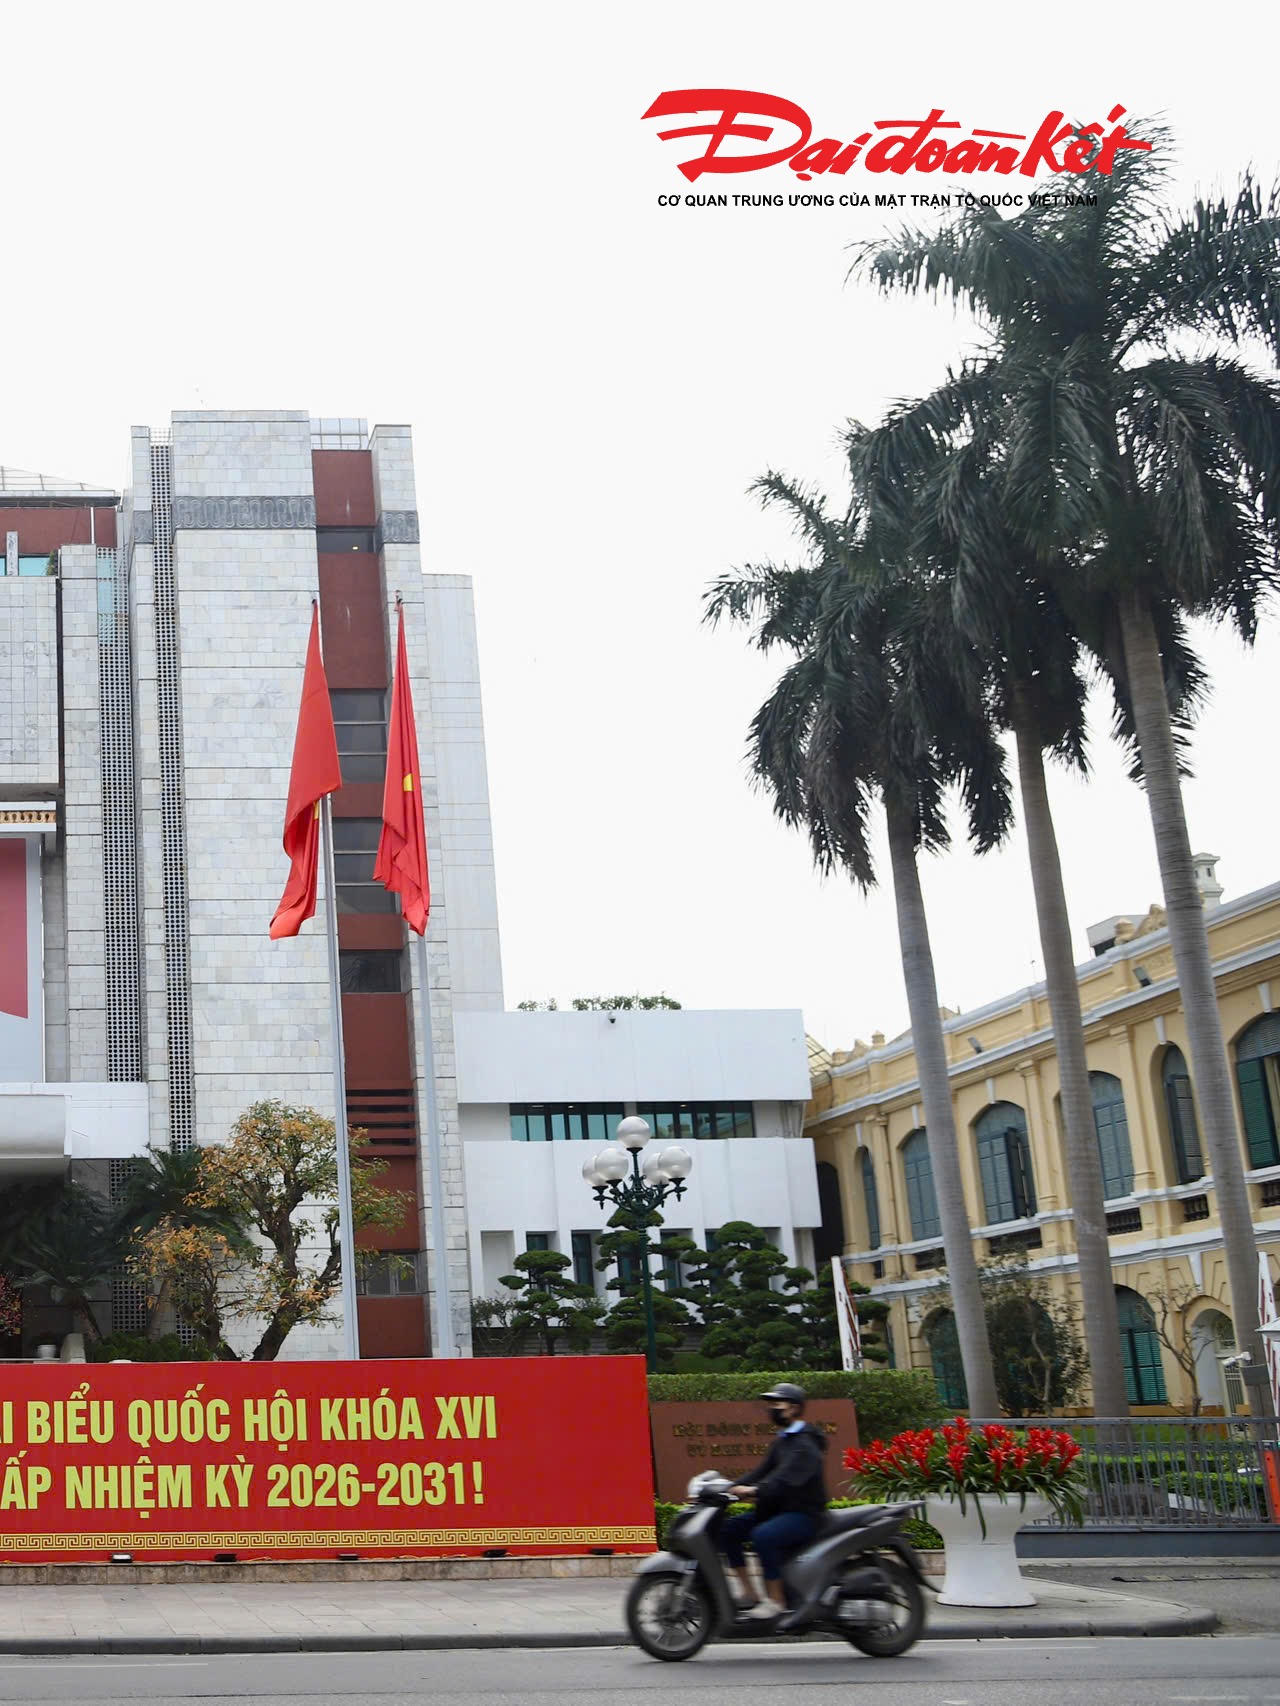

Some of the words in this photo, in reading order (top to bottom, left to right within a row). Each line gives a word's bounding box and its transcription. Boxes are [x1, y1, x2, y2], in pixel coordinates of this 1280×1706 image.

[28, 1382, 114, 1444] BIỂU
[127, 1383, 231, 1449] QUỐC
[244, 1389, 307, 1452] HỘI
[320, 1387, 425, 1441] KHÓA
[434, 1396, 497, 1440] XVI
[65, 1456, 193, 1519] NHIỆM
[206, 1454, 255, 1508] KỲ
[268, 1462, 485, 1508] 2026-2031!
